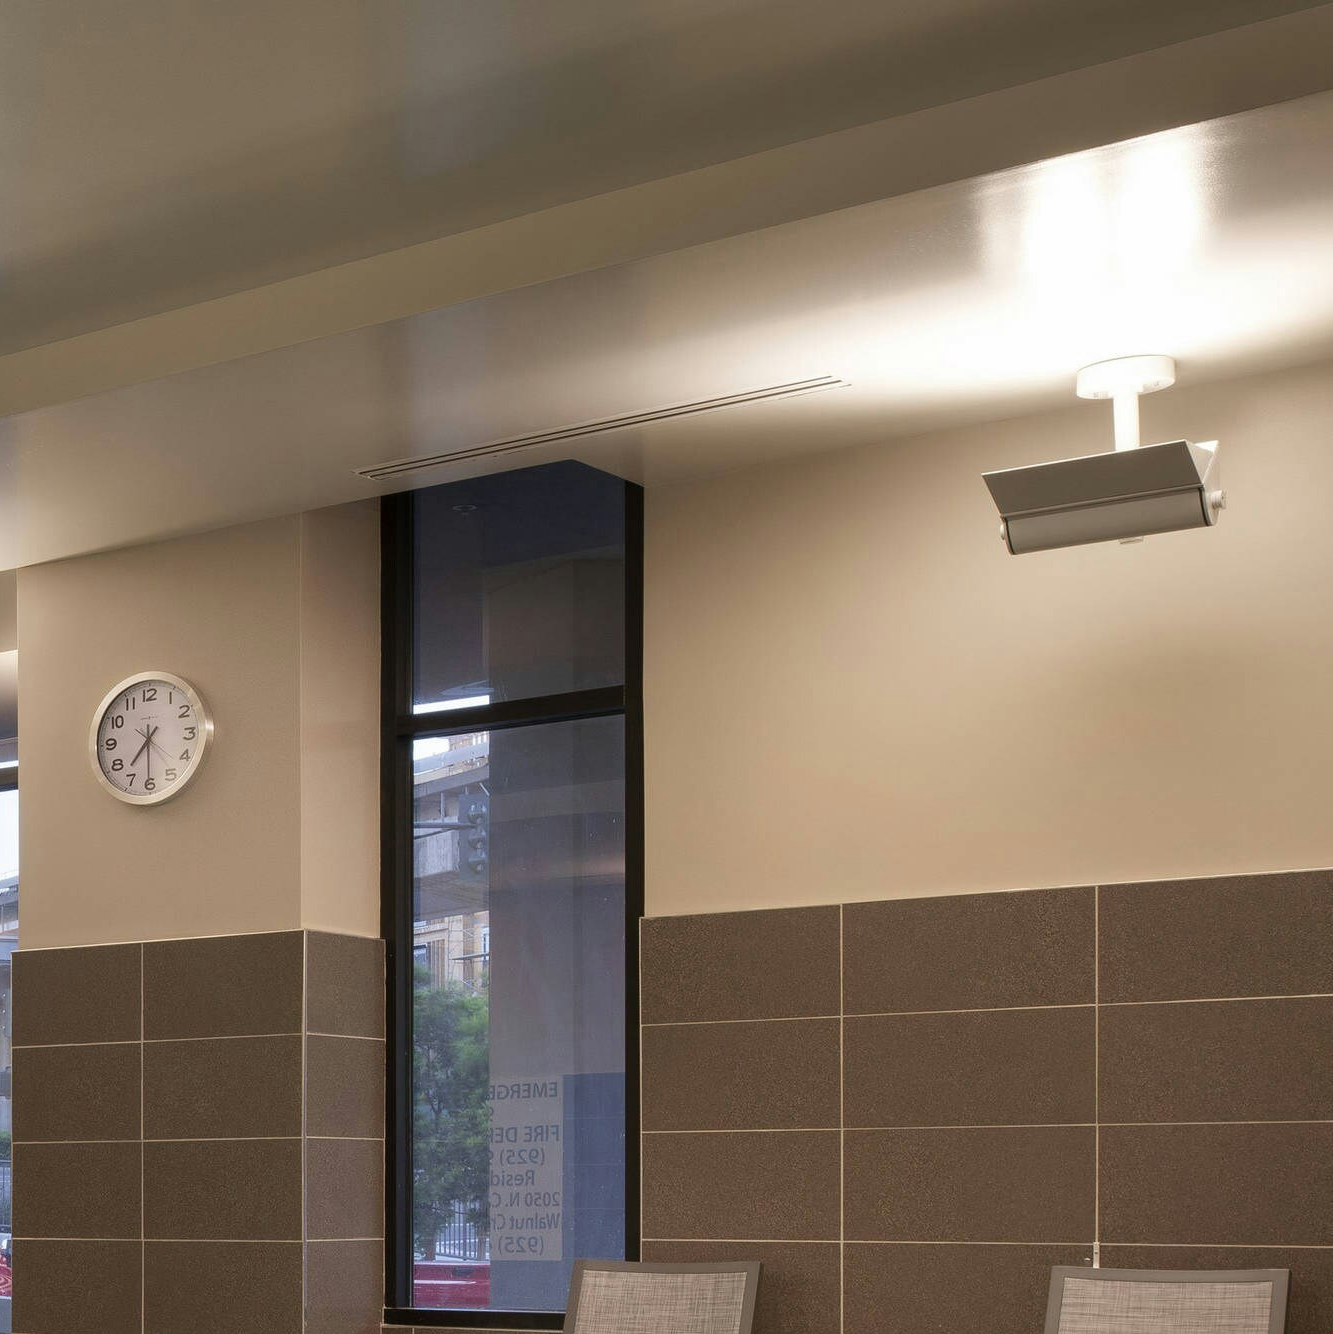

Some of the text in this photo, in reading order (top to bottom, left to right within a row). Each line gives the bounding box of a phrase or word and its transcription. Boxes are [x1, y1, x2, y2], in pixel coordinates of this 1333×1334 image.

[142, 688, 157, 702] 12
[169, 691, 173, 704] 1
[126, 697, 136, 711] 11
[178, 704, 190, 718] 2
[111, 715, 124, 729] 10
[183, 727, 195, 740] 3
[105, 738, 117, 750] 9
[180, 748, 191, 762] 4
[111, 758, 123, 771] 8
[126, 773, 136, 787] 7
[165, 768, 177, 781] 5
[144, 777, 156, 790] 6
